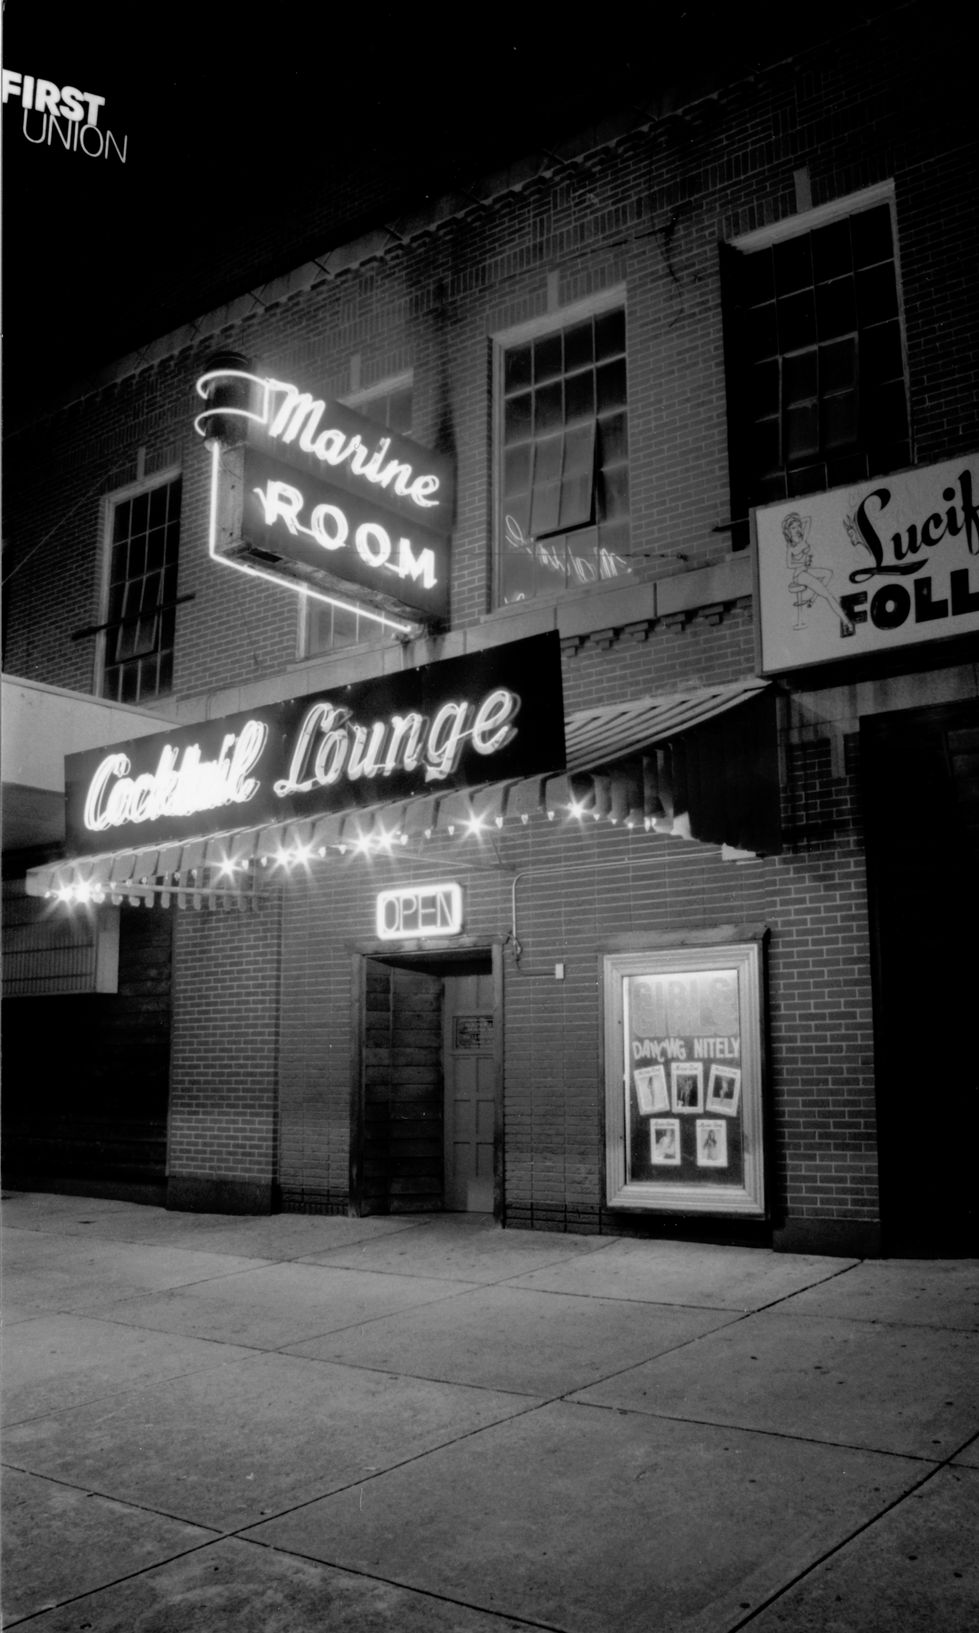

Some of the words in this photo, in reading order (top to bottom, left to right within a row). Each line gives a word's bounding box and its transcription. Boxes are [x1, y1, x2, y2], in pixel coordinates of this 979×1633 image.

[2, 68, 106, 127] FIRST
[22, 108, 128, 163] UNION
[263, 377, 440, 507] Marine
[253, 479, 438, 589] ROOM
[839, 568, 979, 638] FOLL
[84, 719, 269, 831] Cocktail
[273, 687, 521, 797] Lounge
[382, 891, 458, 934] OPEN
[693, 1037, 740, 1059] NITELY
